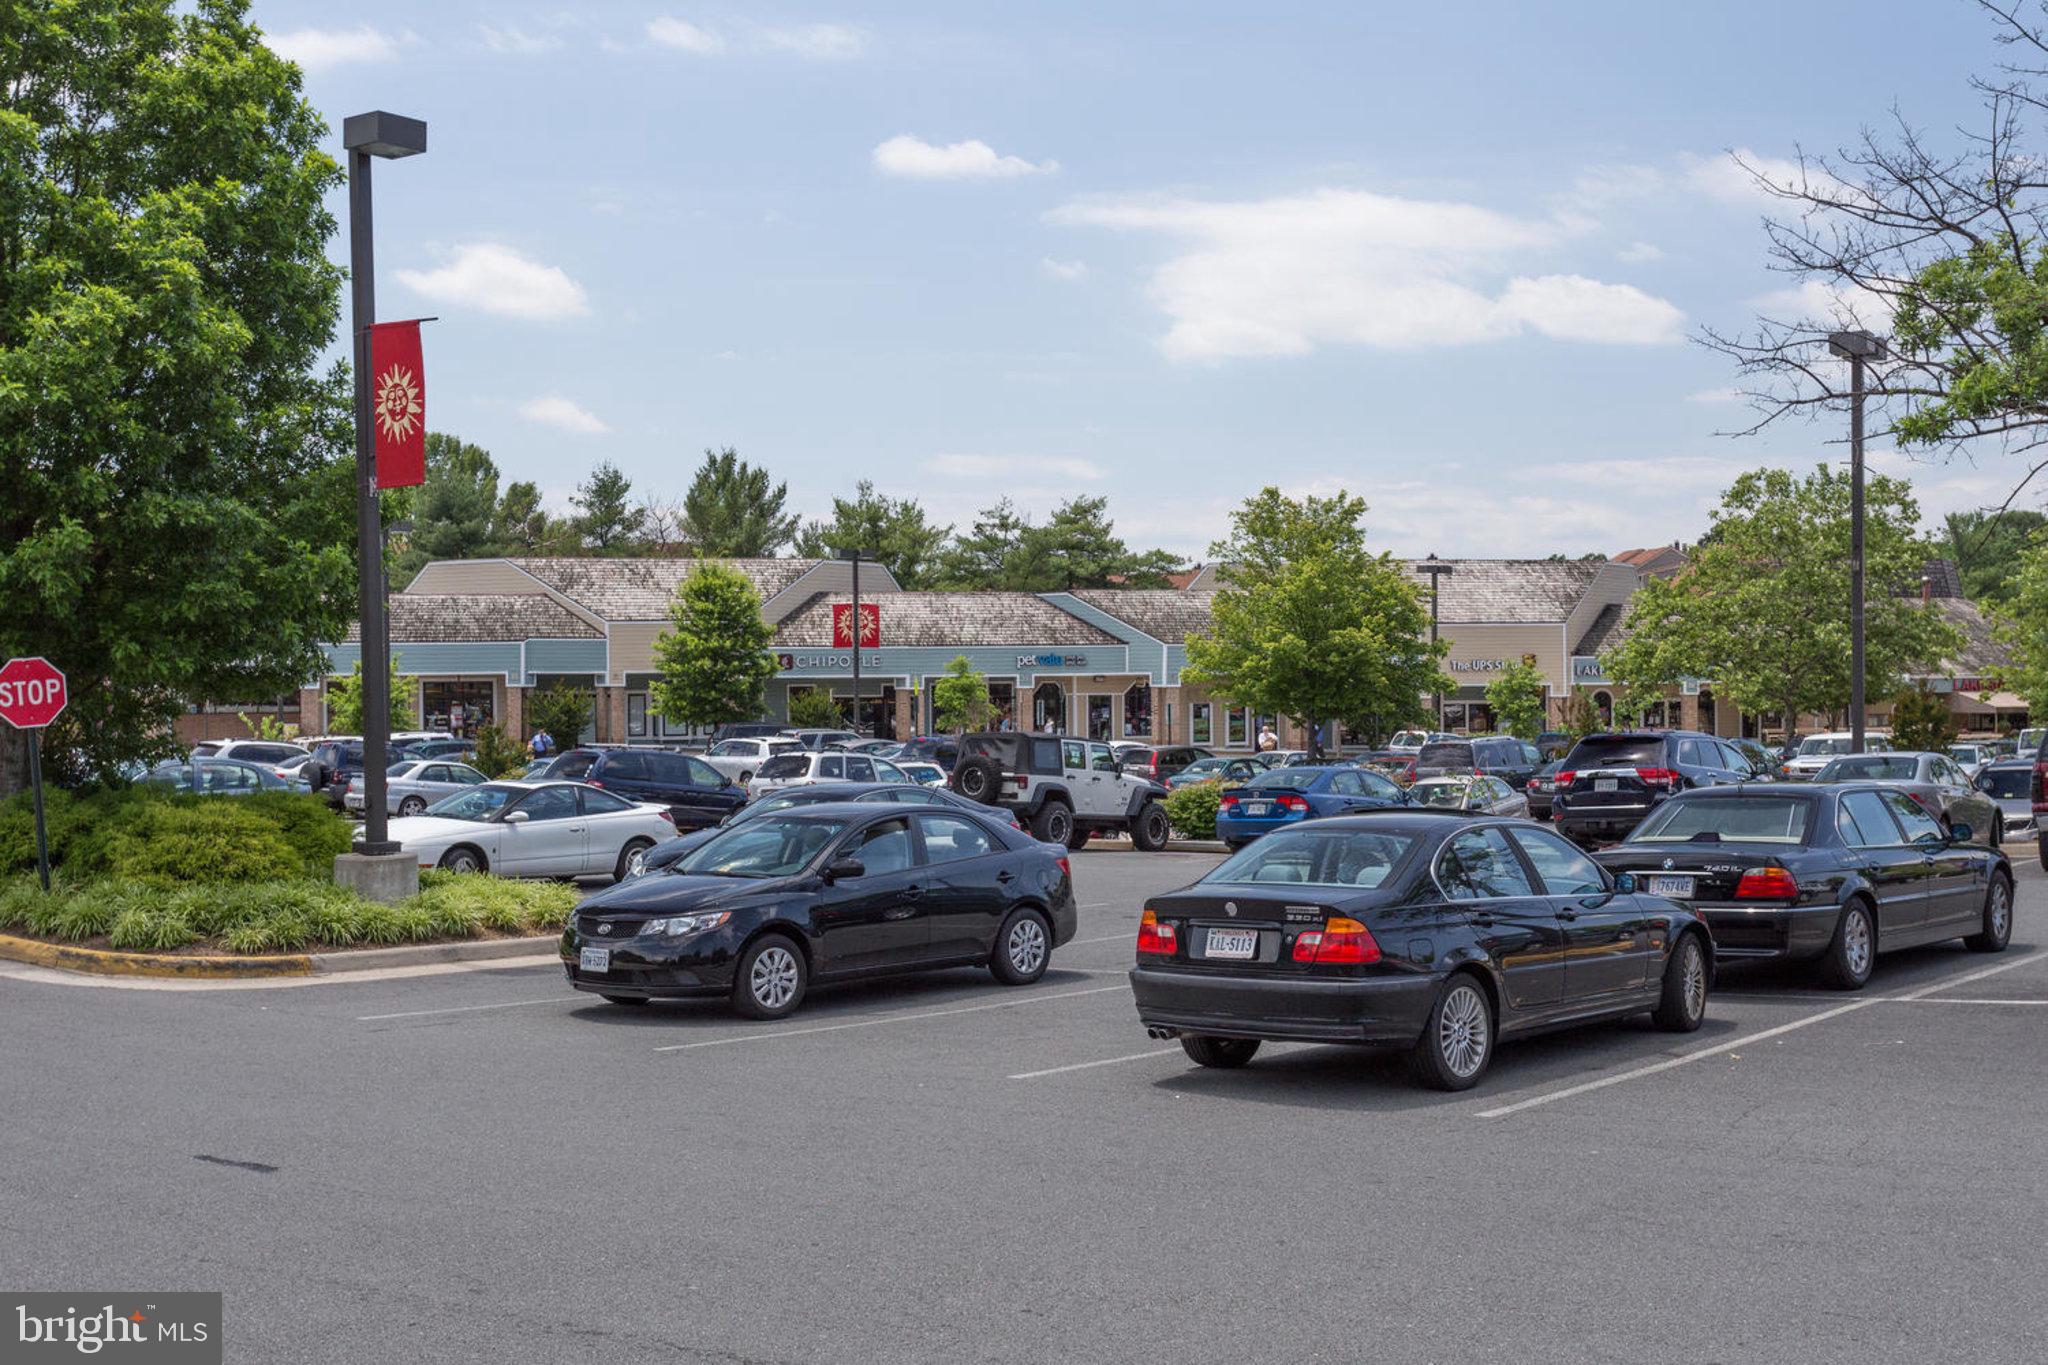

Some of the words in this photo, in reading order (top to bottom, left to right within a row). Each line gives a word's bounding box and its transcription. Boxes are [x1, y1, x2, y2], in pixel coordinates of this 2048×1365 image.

[796, 655, 881, 668] CHIPOLE
[1452, 660, 1470, 671] The
[1472, 659, 1493, 671] UPS
[0, 679, 60, 707] STOP
